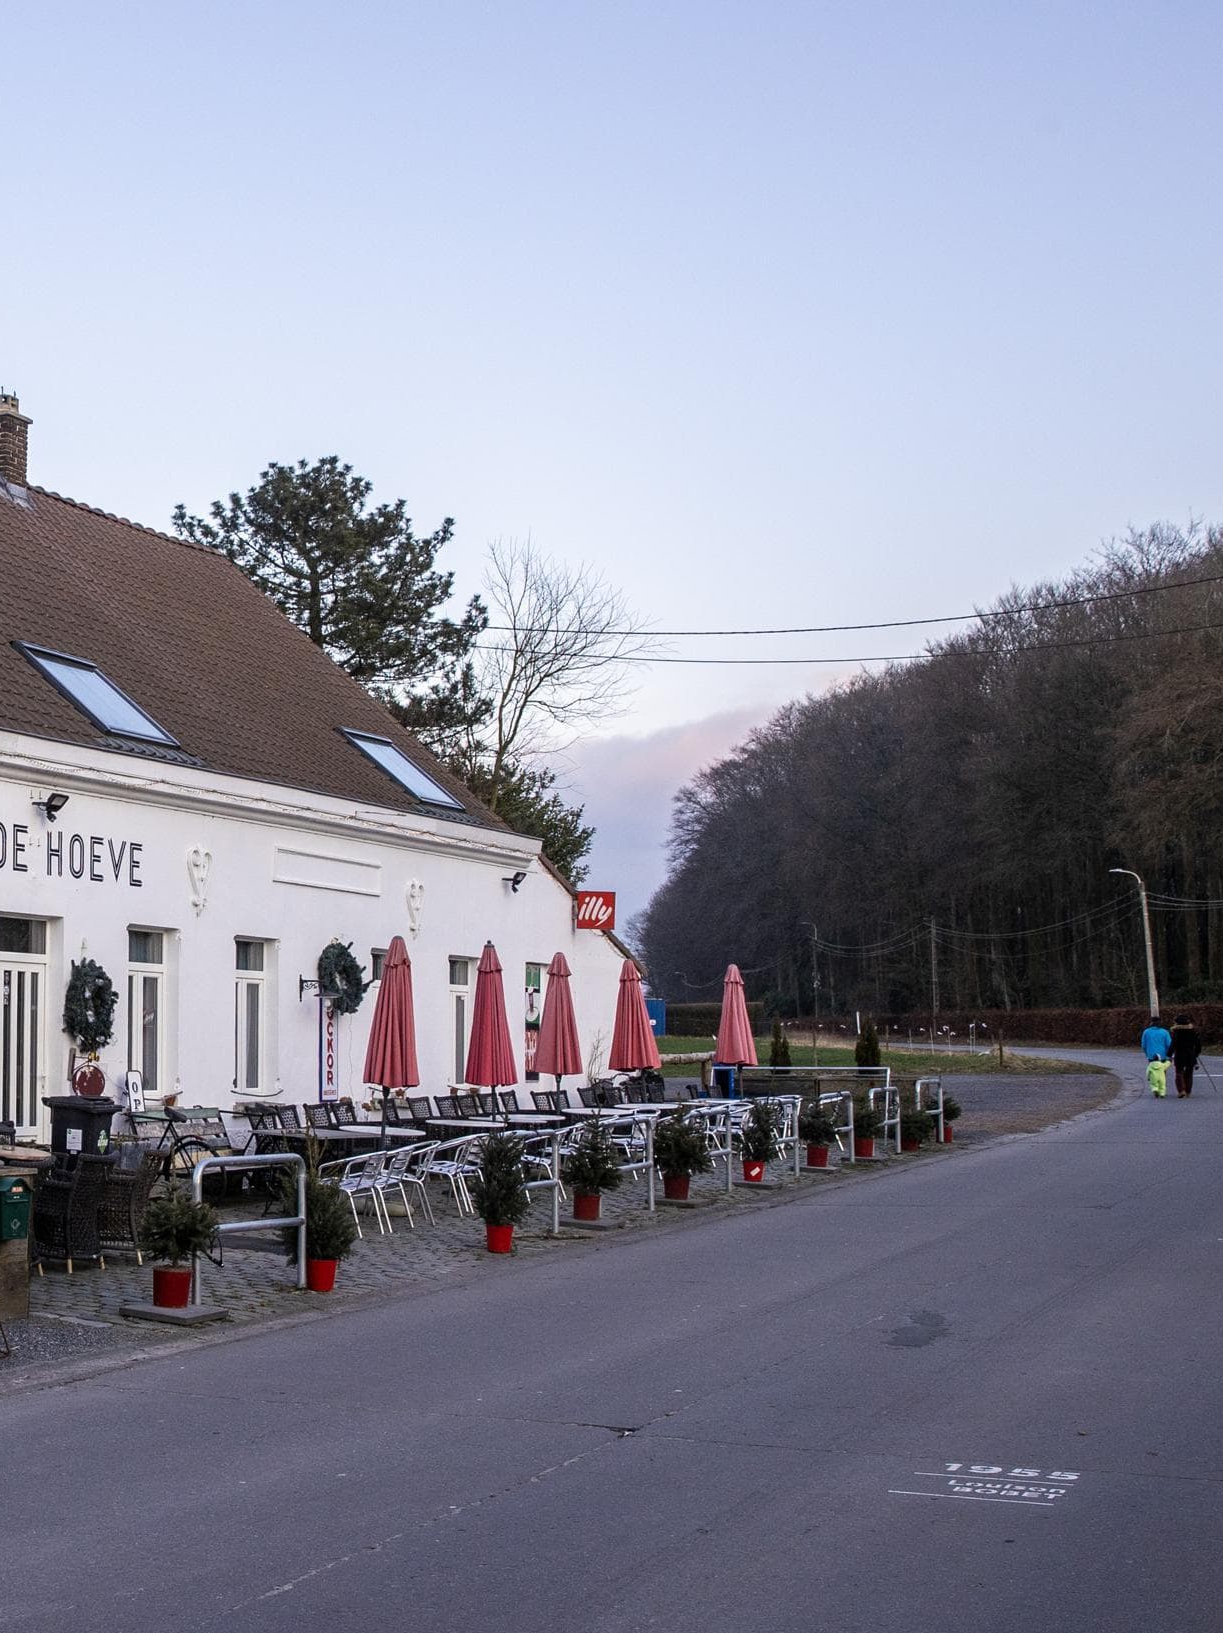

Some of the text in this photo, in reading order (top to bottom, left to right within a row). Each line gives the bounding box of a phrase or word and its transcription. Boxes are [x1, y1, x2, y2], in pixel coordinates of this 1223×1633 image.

[46, 830, 144, 888] HOEVE
[578, 895, 613, 927] illy
[326, 1006, 334, 1086] OCKOR
[945, 1463, 1081, 1480] 1955
[948, 1480, 1066, 1494] Louison
